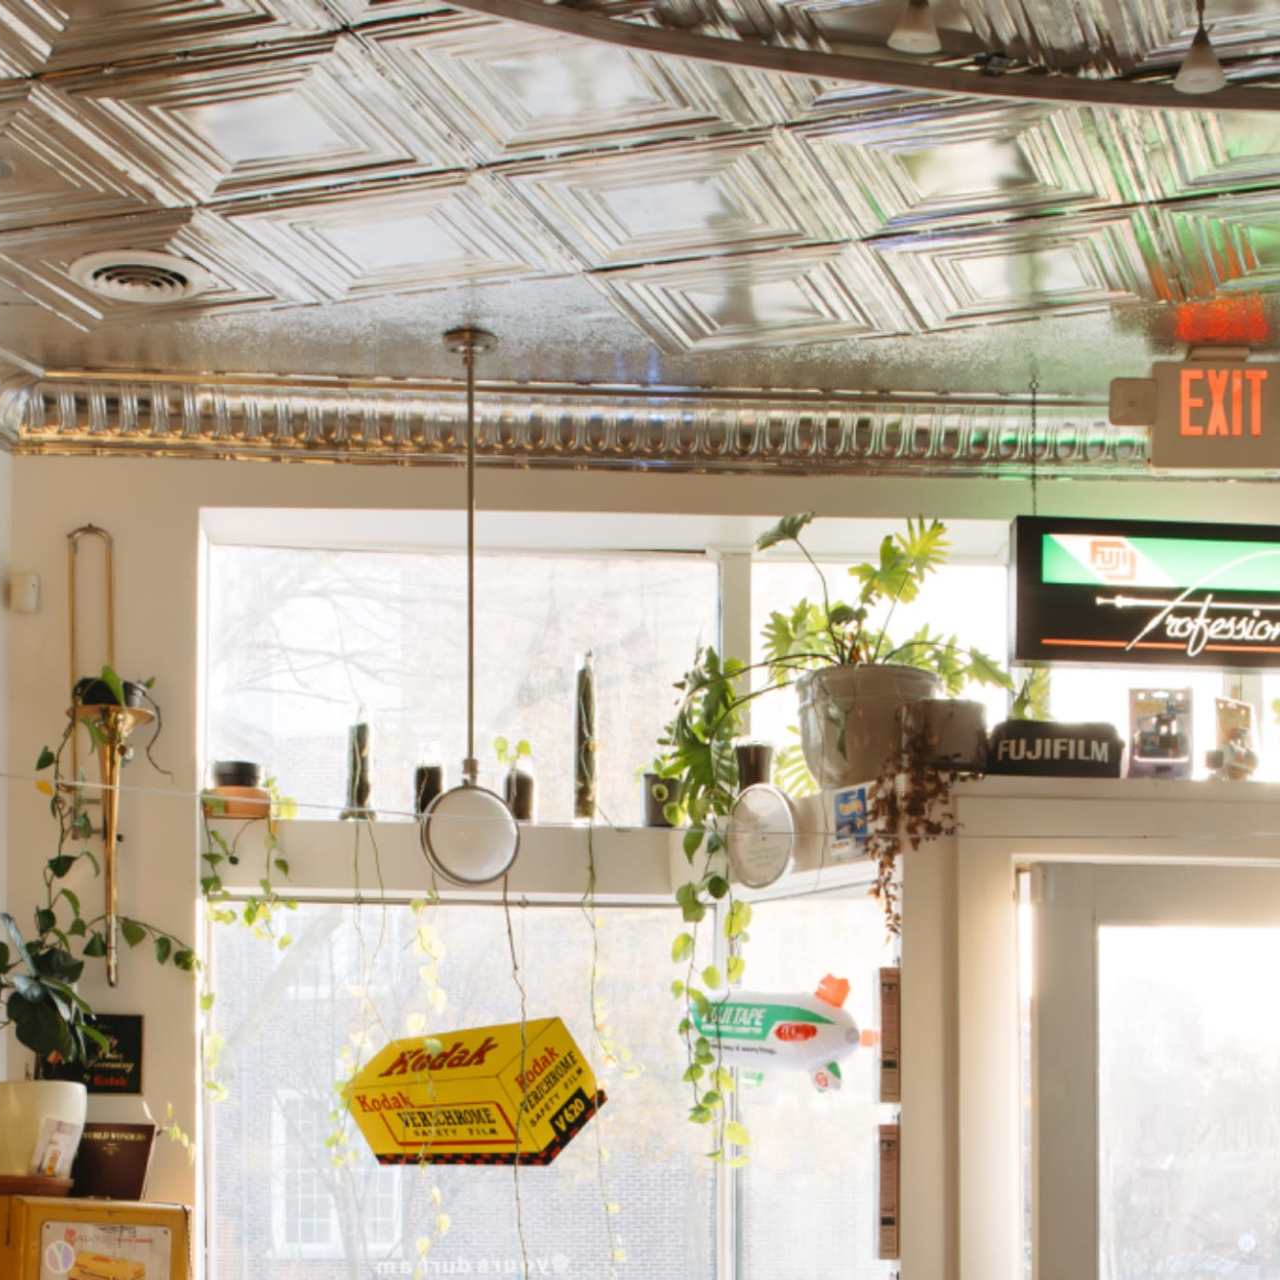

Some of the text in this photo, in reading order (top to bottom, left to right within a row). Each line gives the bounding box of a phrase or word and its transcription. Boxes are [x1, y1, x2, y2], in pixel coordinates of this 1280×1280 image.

[1180, 369, 1268, 436] EXIT
[996, 737, 1110, 763] FUJIFILM
[733, 1007, 767, 1026] TAPE
[378, 1036, 499, 1078] Kodak
[514, 1045, 560, 1093] Kodak
[521, 1051, 577, 1114] VERICHROME
[355, 1091, 416, 1114] Kodak
[554, 1098, 586, 1132] V620
